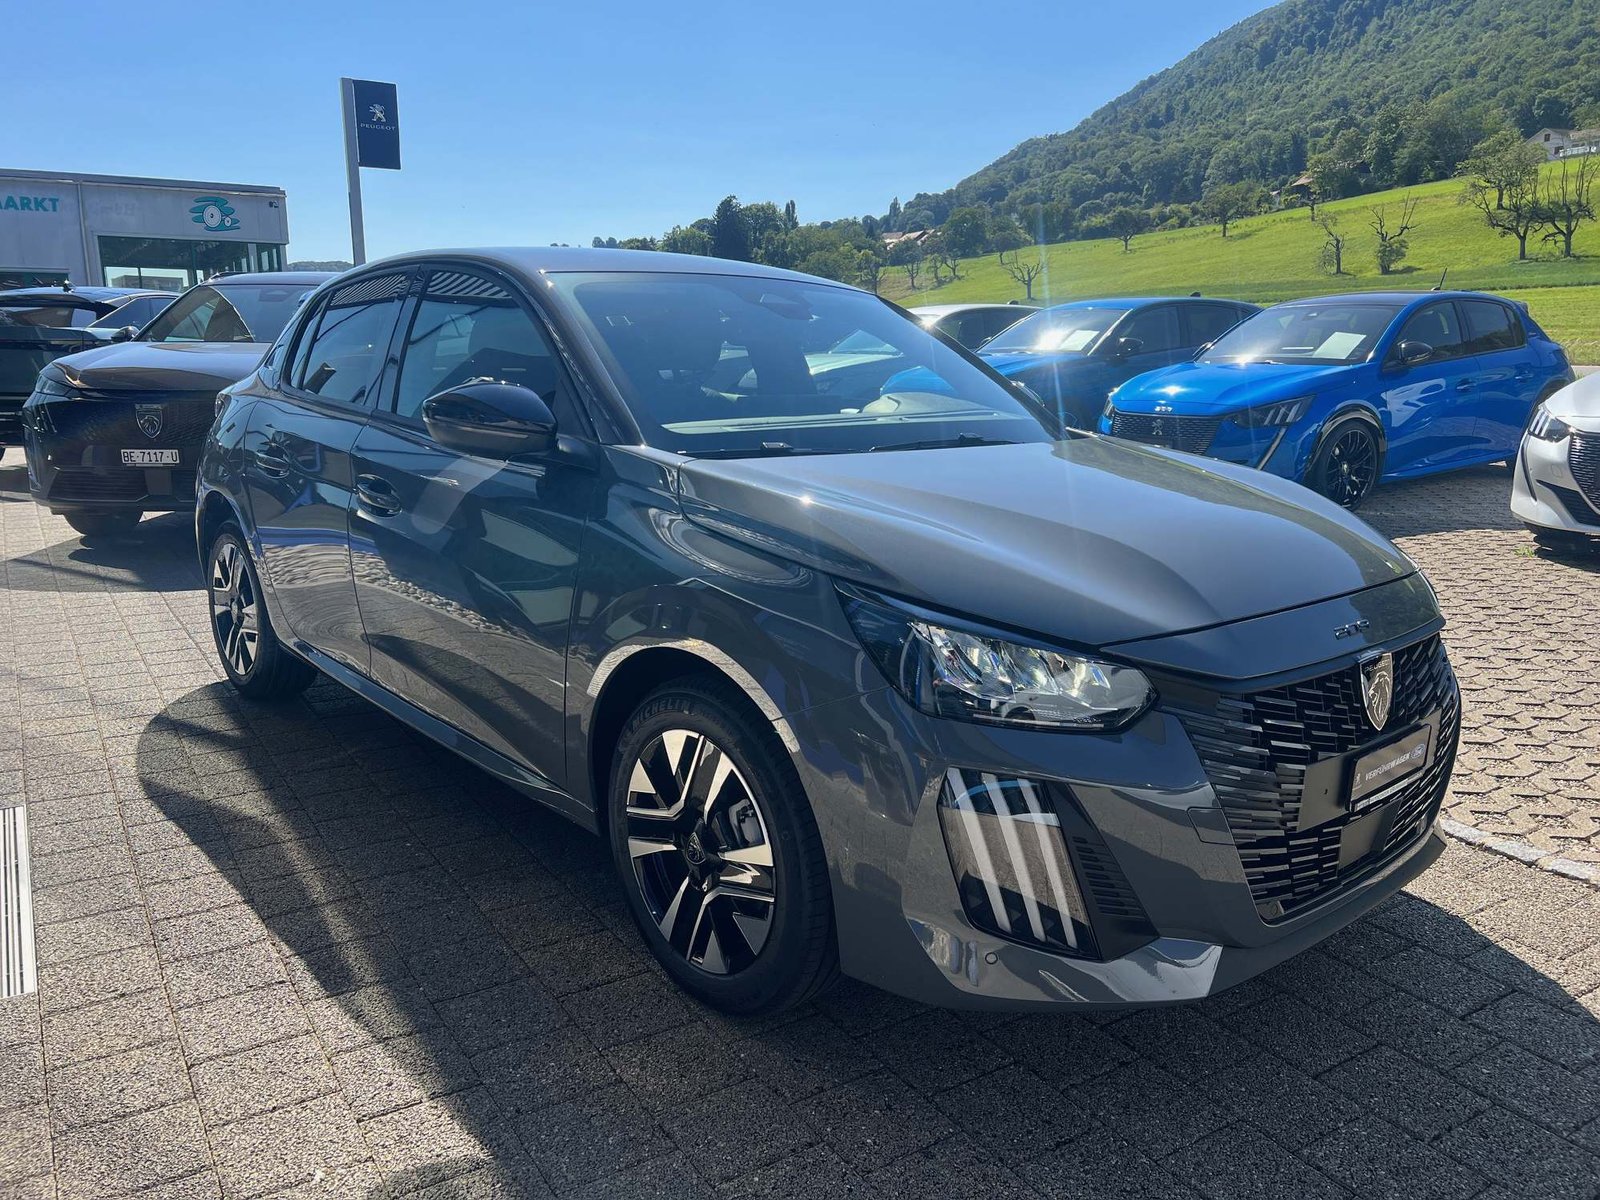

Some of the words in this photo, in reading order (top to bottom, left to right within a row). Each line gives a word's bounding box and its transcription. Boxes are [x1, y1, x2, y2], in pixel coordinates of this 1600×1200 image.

[360, 122, 396, 131] PEUGEOT
[0, 196, 59, 212] ARKT
[631, 697, 692, 734] MICHELIN
